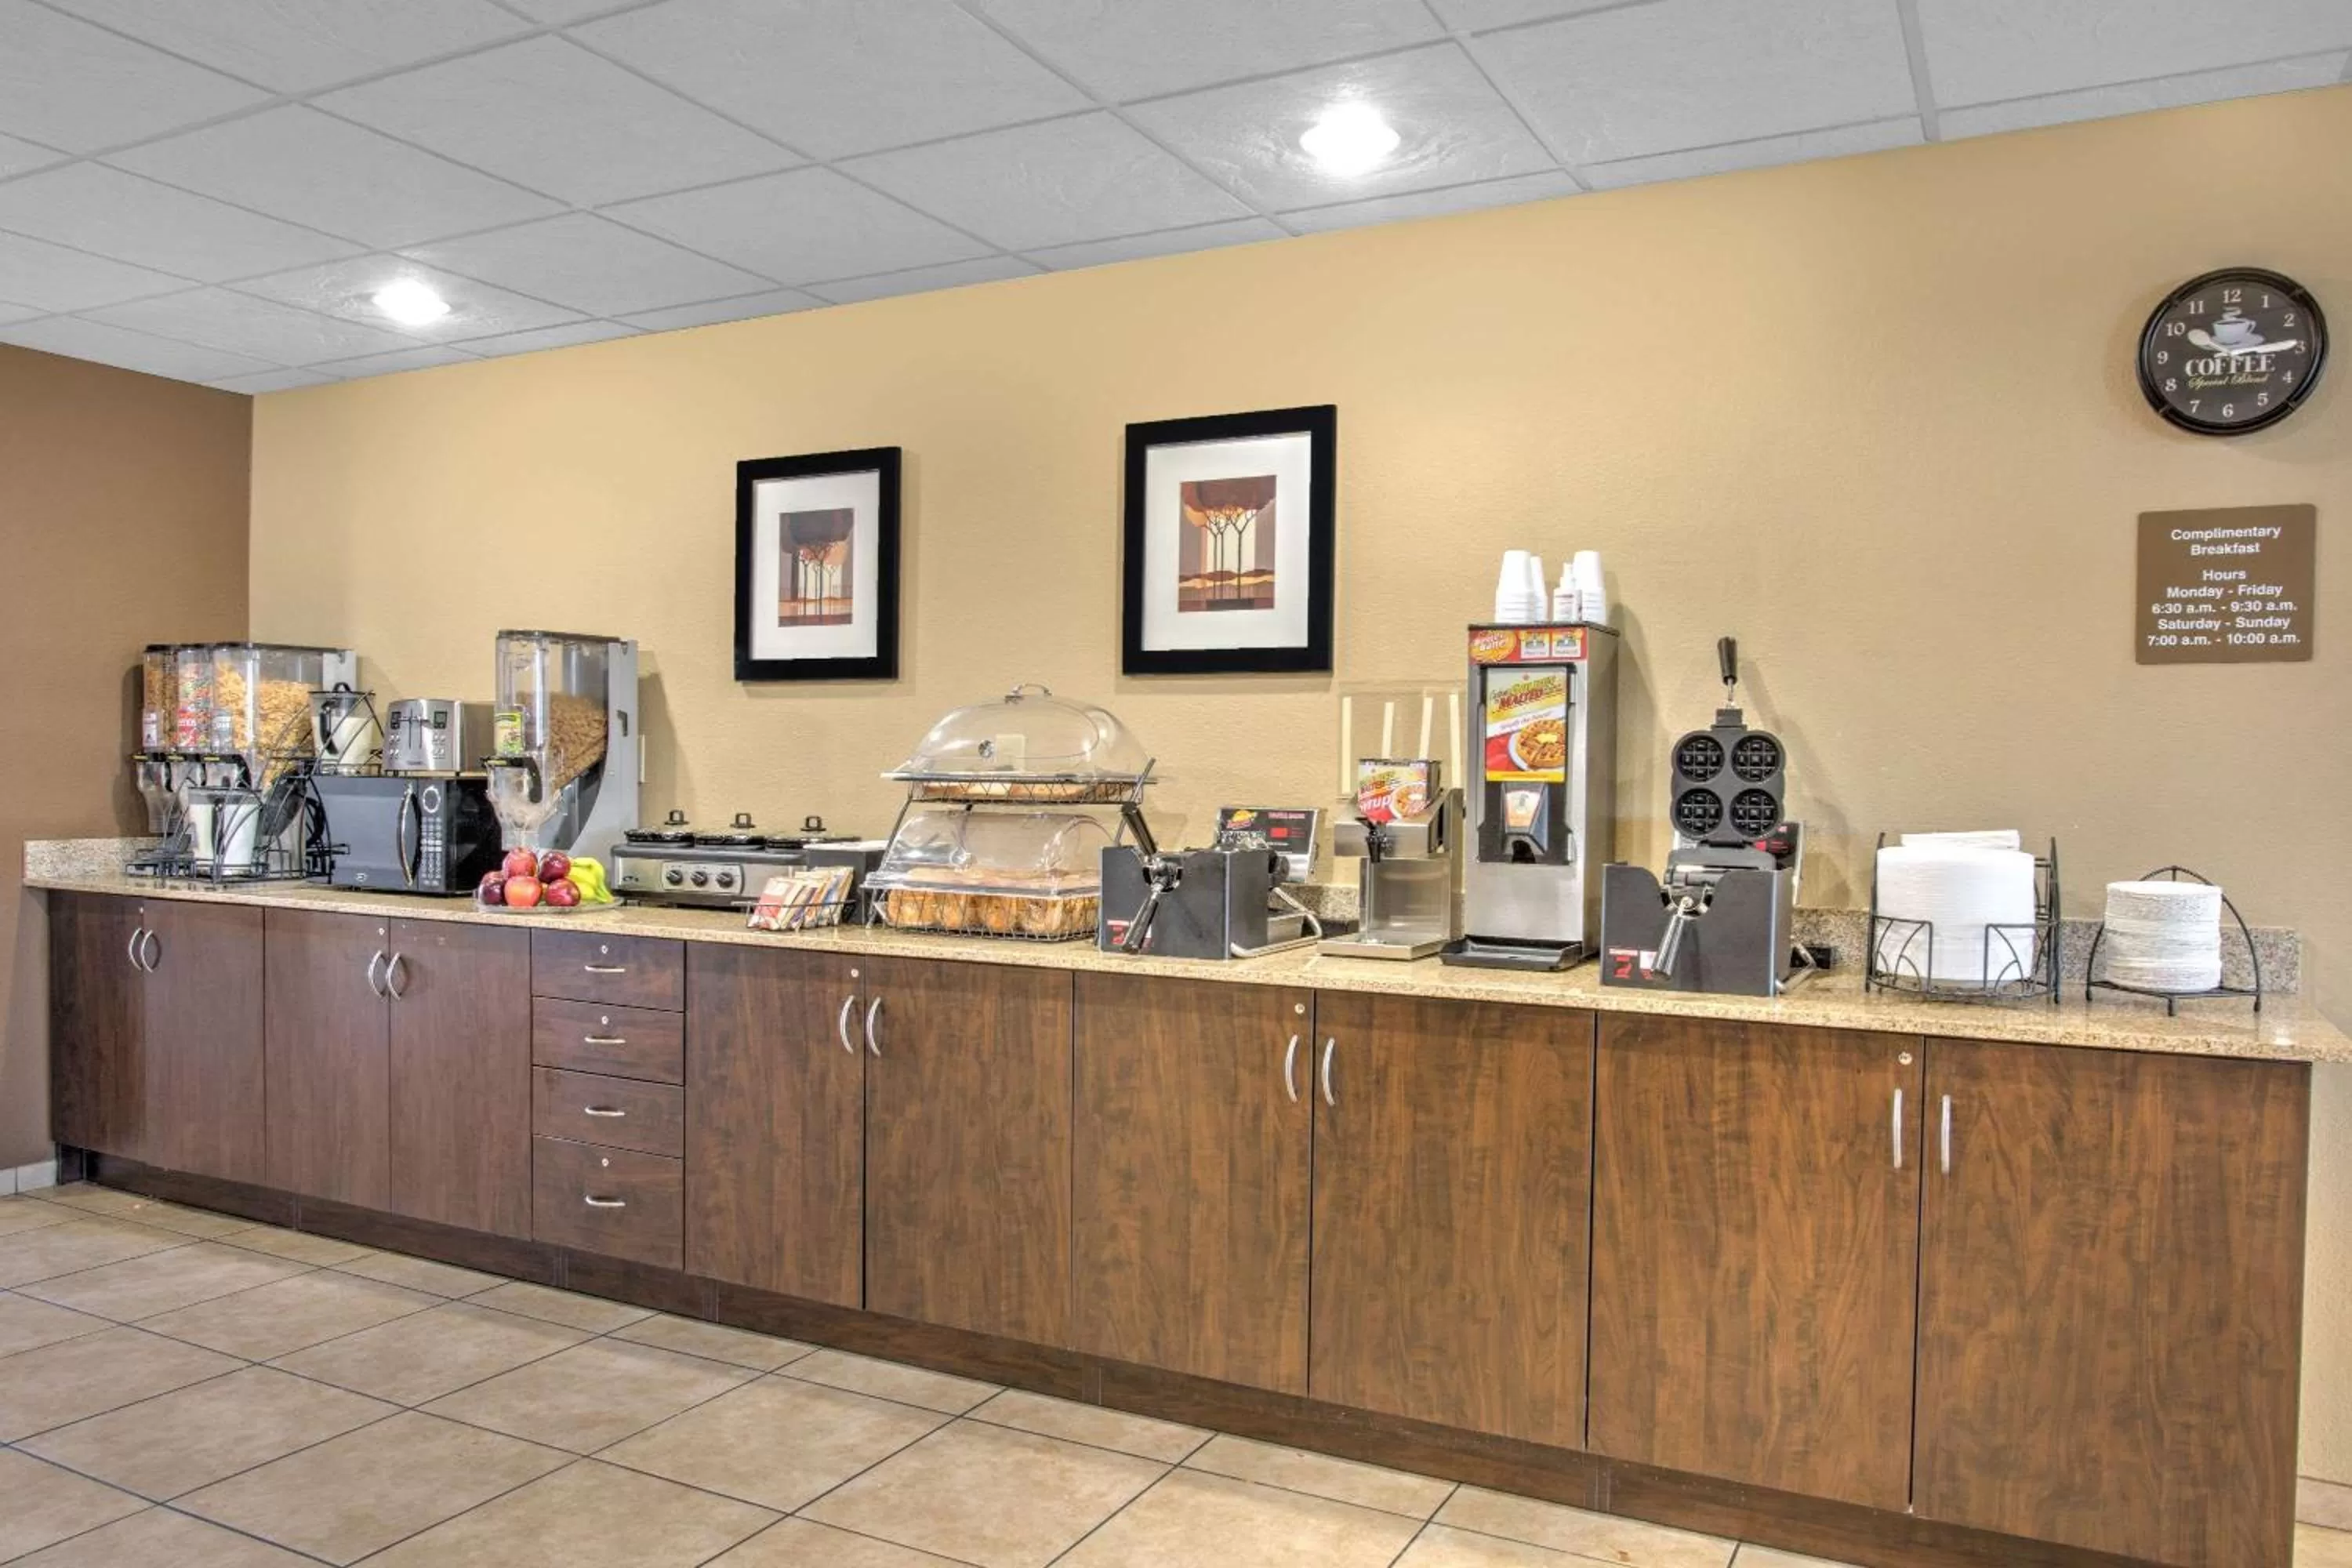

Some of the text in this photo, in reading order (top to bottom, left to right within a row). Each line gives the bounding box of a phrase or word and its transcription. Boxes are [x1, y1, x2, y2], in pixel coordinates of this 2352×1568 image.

[2223, 289, 2242, 303] 12
[2261, 295, 2270, 308] 1
[2188, 300, 2205, 314] 11
[2283, 314, 2296, 328] 2
[2165, 322, 2186, 336] 10
[2294, 340, 2306, 354] 3
[2157, 351, 2169, 365] 9
[2185, 354, 2276, 377] COFFEE
[2282, 370, 2293, 383] 4
[2165, 378, 2177, 392] 8
[2257, 393, 2268, 406] 5
[2189, 400, 2201, 414] 7
[2222, 403, 2234, 418] 6
[2171, 526, 2281, 541] Complimentary
[2190, 543, 2260, 556] Breakfast
[2202, 570, 2246, 581] Hours
[2166, 586, 2224, 599] Monday
[2238, 584, 2283, 597] Friday
[2151, 603, 2182, 614] 6:30
[2186, 604, 2216, 614] a.m.
[2230, 601, 2262, 612] 9:30
[2266, 601, 2298, 612] a.m.
[2158, 618, 2221, 631] Saturday
[2235, 616, 2291, 629] Sunday
[2147, 635, 2177, 646] 7:00
[2181, 636, 2212, 645] a.m.
[2227, 633, 2265, 644] 10:00
[2269, 633, 2301, 643] a.m.
